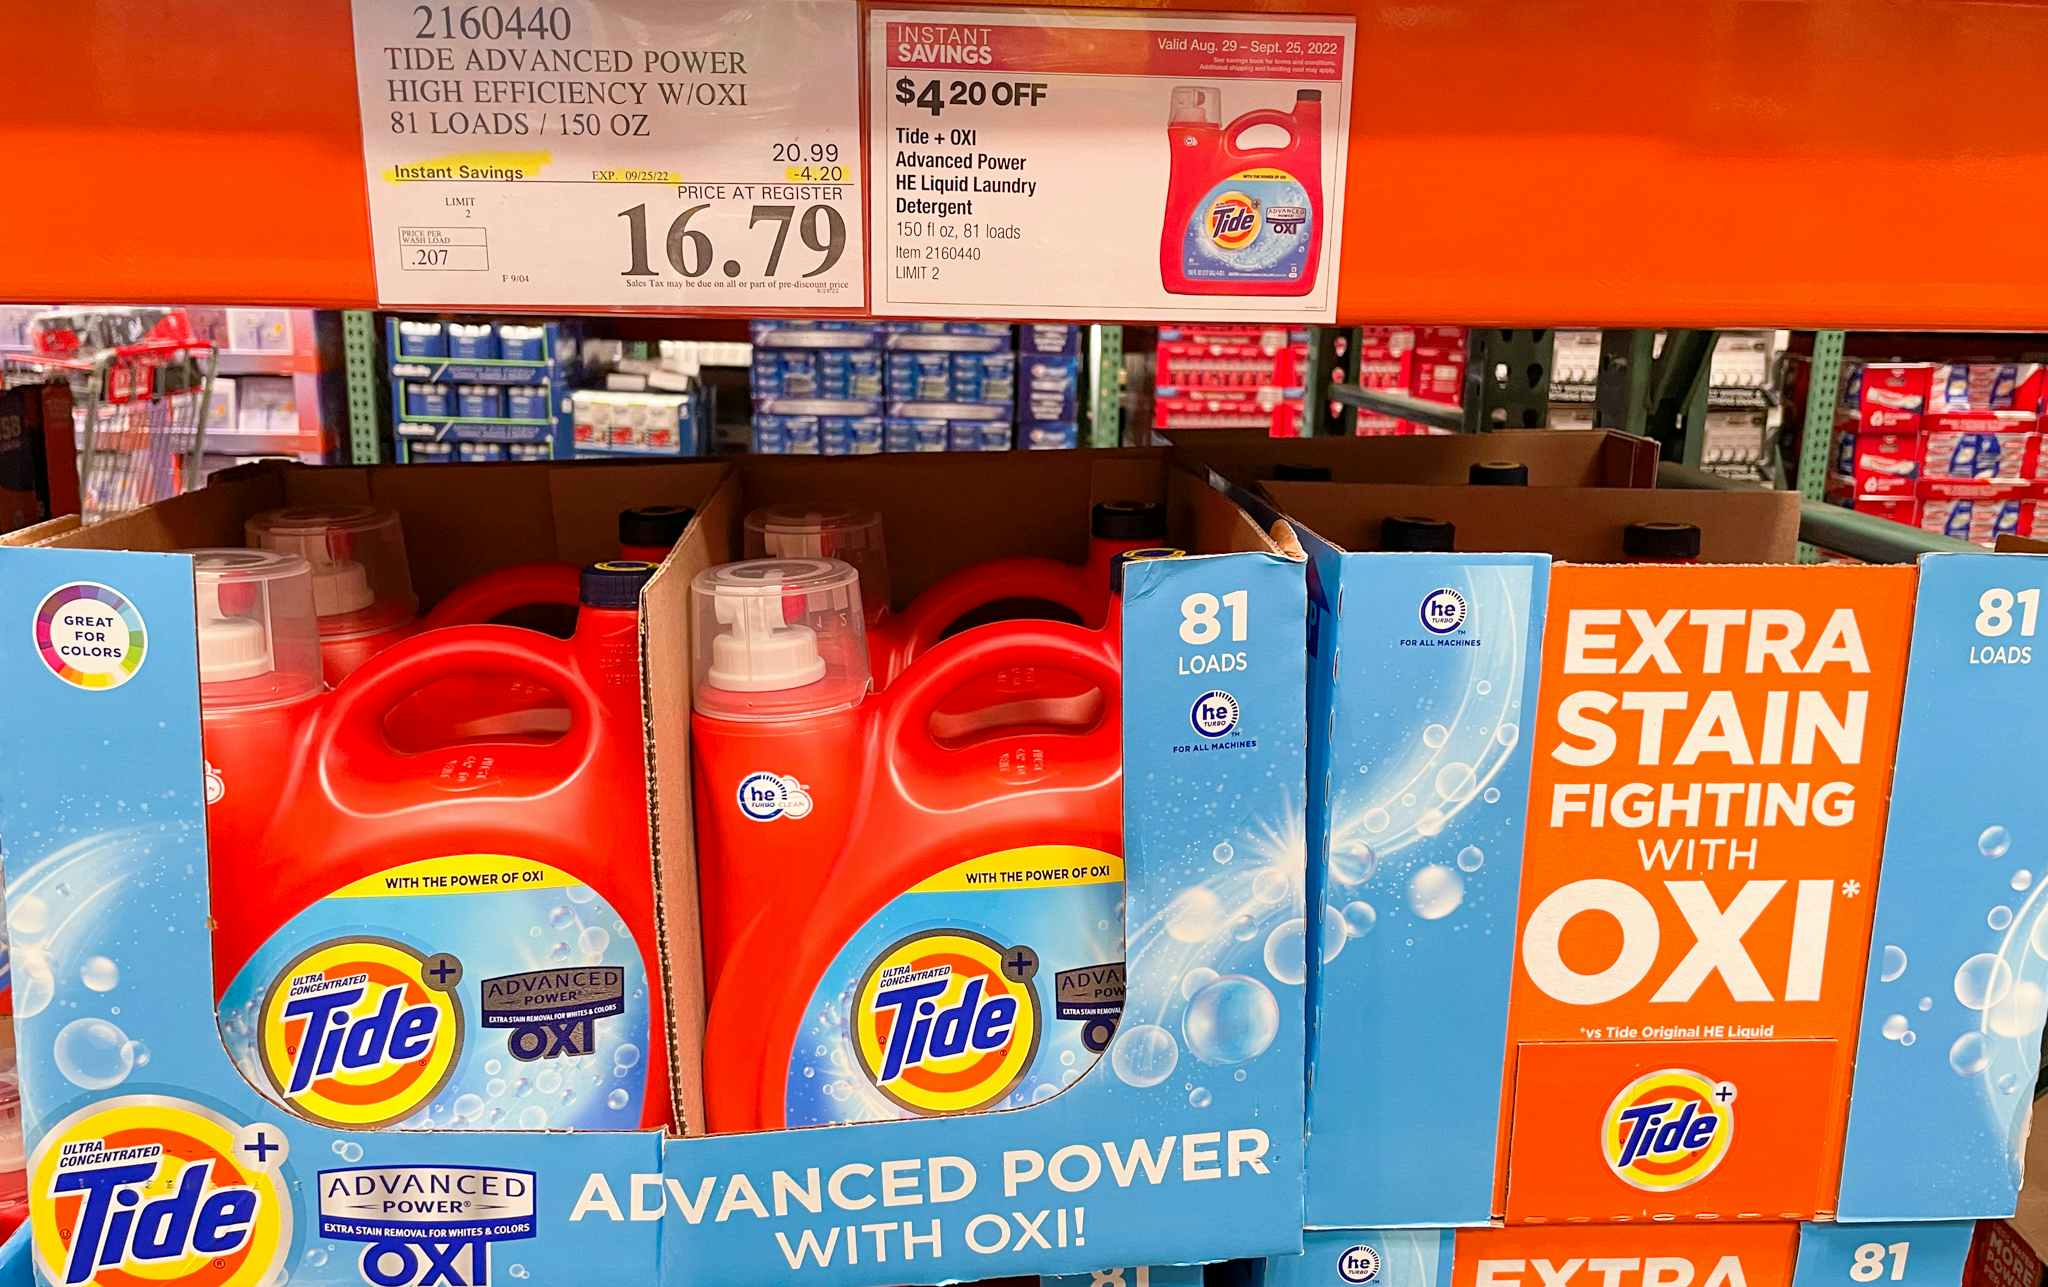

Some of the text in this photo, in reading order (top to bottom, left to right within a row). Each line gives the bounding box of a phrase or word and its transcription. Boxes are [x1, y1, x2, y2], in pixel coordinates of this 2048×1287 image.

[412, 5, 571, 41] 2160440
[898, 26, 992, 45] INSTANT
[898, 44, 992, 65] SAVINGS
[1158, 37, 1338, 56] Valid Aug. 29 Sept. 25, 2022
[384, 47, 747, 75] TIDE ADVANCED POWER
[387, 79, 747, 107] HIGH EFFICIENCY W/OXI
[992, 81, 1048, 107] OFF
[390, 111, 651, 138] 81 LOADS / 150 OZ
[896, 127, 976, 146] Tide + OXI
[772, 143, 839, 163] 20.99
[896, 151, 1027, 171] Advanced Power
[394, 164, 524, 182] Instant Savings
[592, 171, 669, 181] EXP. 09/25/22
[793, 166, 843, 182] -4.20
[678, 186, 843, 201] PRICE AT REGISTER
[896, 174, 1037, 198] HE Liquid Laundry
[445, 197, 476, 207] LIMIT
[896, 197, 973, 218] Detergent
[464, 209, 472, 218] 2
[1212, 206, 1255, 238] Tide
[897, 221, 1021, 240] 150 fl oz, 81 loads
[1273, 223, 1297, 235] OXI
[617, 203, 847, 278] 16.79
[411, 249, 448, 265] .207
[896, 245, 981, 261] Item 2160440
[895, 266, 940, 280] LIMIT 2
[626, 279, 646, 288] Sales
[648, 279, 664, 288] Tax
[666, 281, 683, 290] may
[685, 280, 695, 288] be
[697, 280, 711, 288] due
[726, 280, 736, 289] all
[750, 281, 765, 291] part
[767, 280, 777, 289] of
[779, 280, 827, 291] pre-discount
[829, 281, 848, 291] price
[1179, 590, 1248, 645] 81
[1431, 600, 1456, 617] he
[1975, 588, 2040, 637] 81
[64, 615, 114, 628] GREAT
[75, 631, 105, 642] FOR
[1400, 639, 1481, 647] FOR ALL MACHINES
[1563, 608, 1871, 674] EXTRA
[60, 645, 122, 658] COLORS
[1969, 645, 2032, 665] LOADS
[1178, 652, 1248, 675] LOADS
[1202, 703, 1228, 721] he
[1551, 689, 1869, 767] STAIN
[1173, 740, 1257, 753] FOR ALL MACHINES
[750, 786, 775, 801] he
[1550, 781, 1855, 828] FIGHTING
[1637, 838, 1758, 871] WITH
[385, 870, 544, 890] WITH THE POWER OF OXI
[966, 865, 1110, 884] WITH THE POWER OF OXI
[292, 973, 323, 986] ULTRA
[879, 966, 951, 988] CONCENTRATED
[882, 965, 911, 979] ULTRA
[289, 973, 368, 997] CONCENTRATED
[488, 971, 618, 998] ADVANCED
[489, 1004, 617, 1024] EXTRA STAIN REMOVAL FOR WHITES COLORS
[284, 987, 439, 1093] Tide
[875, 978, 1017, 1082] Tide
[1606, 1026, 1638, 1038] Tide
[1642, 1025, 1700, 1040] Original
[1704, 1025, 1724, 1037] HE
[1728, 1024, 1774, 1039] Liquid
[510, 1021, 595, 1060] OXI
[1618, 1101, 1718, 1168] Tide
[60, 1146, 160, 1168] CONCENTRATED
[63, 1140, 103, 1155] ULTRA
[328, 1174, 526, 1198] ADVANCED
[568, 1128, 1271, 1225] ADVANCED POWER
[54, 1162, 257, 1285] Tide
[324, 1222, 530, 1238] EXTRA STAIN REMOVAL FOR WHITES & COLORS
[775, 1206, 1087, 1271] WITH OXI!
[362, 1241, 489, 1287] OXI
[1348, 1256, 1371, 1269] he
[1849, 1241, 1910, 1282] 81
